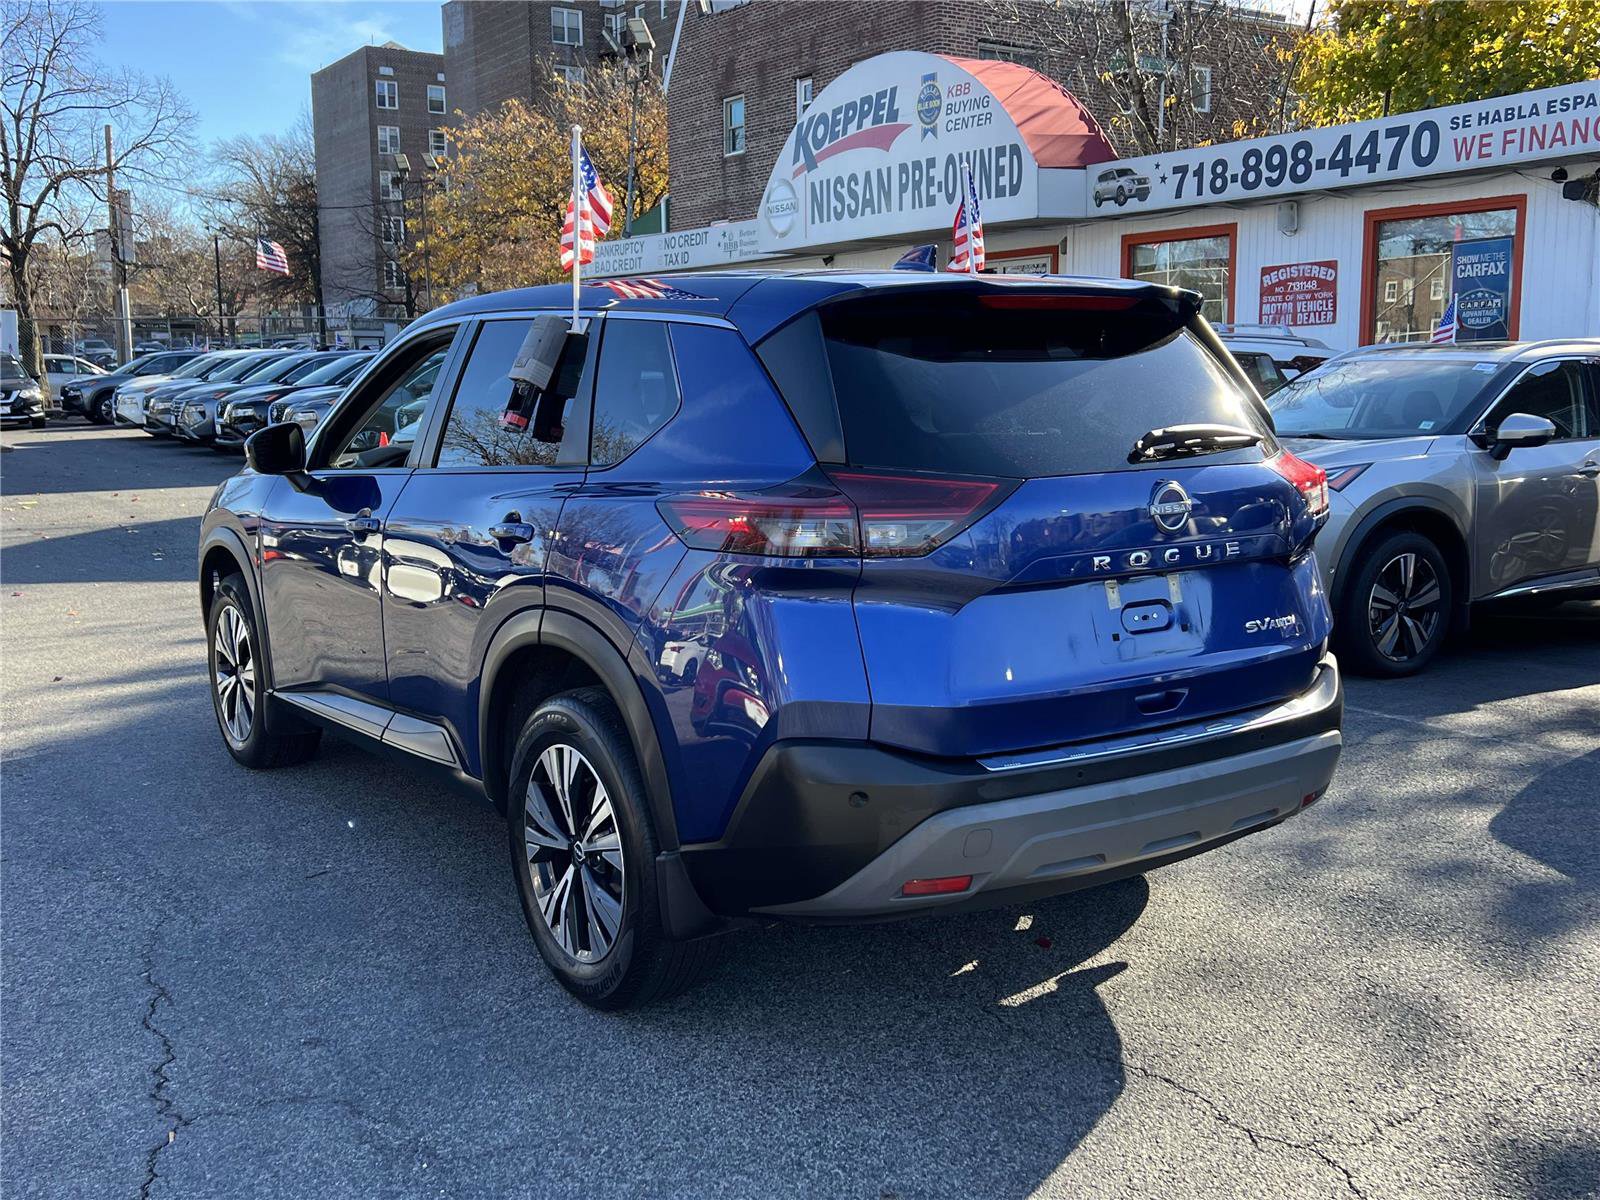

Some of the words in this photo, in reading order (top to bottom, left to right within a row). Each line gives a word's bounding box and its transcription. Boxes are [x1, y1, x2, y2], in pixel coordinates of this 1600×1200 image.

[947, 82, 971, 98] KBB
[945, 95, 990, 117] BUYING
[1449, 114, 1472, 131] SE
[1477, 103, 1540, 126] HABLA
[1546, 92, 1600, 115] ESPA
[792, 85, 899, 173] KOEPPEL
[945, 112, 993, 133] CENTER
[1453, 132, 1494, 162] WE
[1172, 120, 1440, 199] 718-898-4470
[810, 166, 892, 225] NISSAN
[898, 143, 1023, 212] PRE-OWNED
[767, 202, 796, 214] NISSAN
[664, 236, 676, 249] NO
[677, 231, 709, 247] CREDIT
[723, 241, 739, 250] BBB
[595, 240, 645, 258] BANKRUPTCY
[595, 260, 611, 273] BAD
[612, 257, 642, 271] CREDIT
[664, 253, 680, 266] TAX
[680, 251, 690, 265] ID
[1457, 254, 1479, 264] SHOW
[1480, 253, 1491, 262] ME
[1492, 251, 1505, 261] THE
[1262, 265, 1336, 287] REGISTERED
[1457, 261, 1507, 278] CARFAX
[1262, 295, 1283, 303] STATE
[1314, 291, 1334, 299] YORK
[1460, 299, 1502, 309] CARFAX
[1262, 302, 1293, 314] MOTOR
[1297, 300, 1334, 312] VEHICLE
[1462, 309, 1498, 318] ADVANTAGE
[1297, 311, 1333, 324] DEALER
[1467, 317, 1491, 325] DEALER
[1151, 501, 1192, 514] NISSAN
[1093, 541, 1240, 572] ROGUE
[1245, 617, 1271, 633] SV
